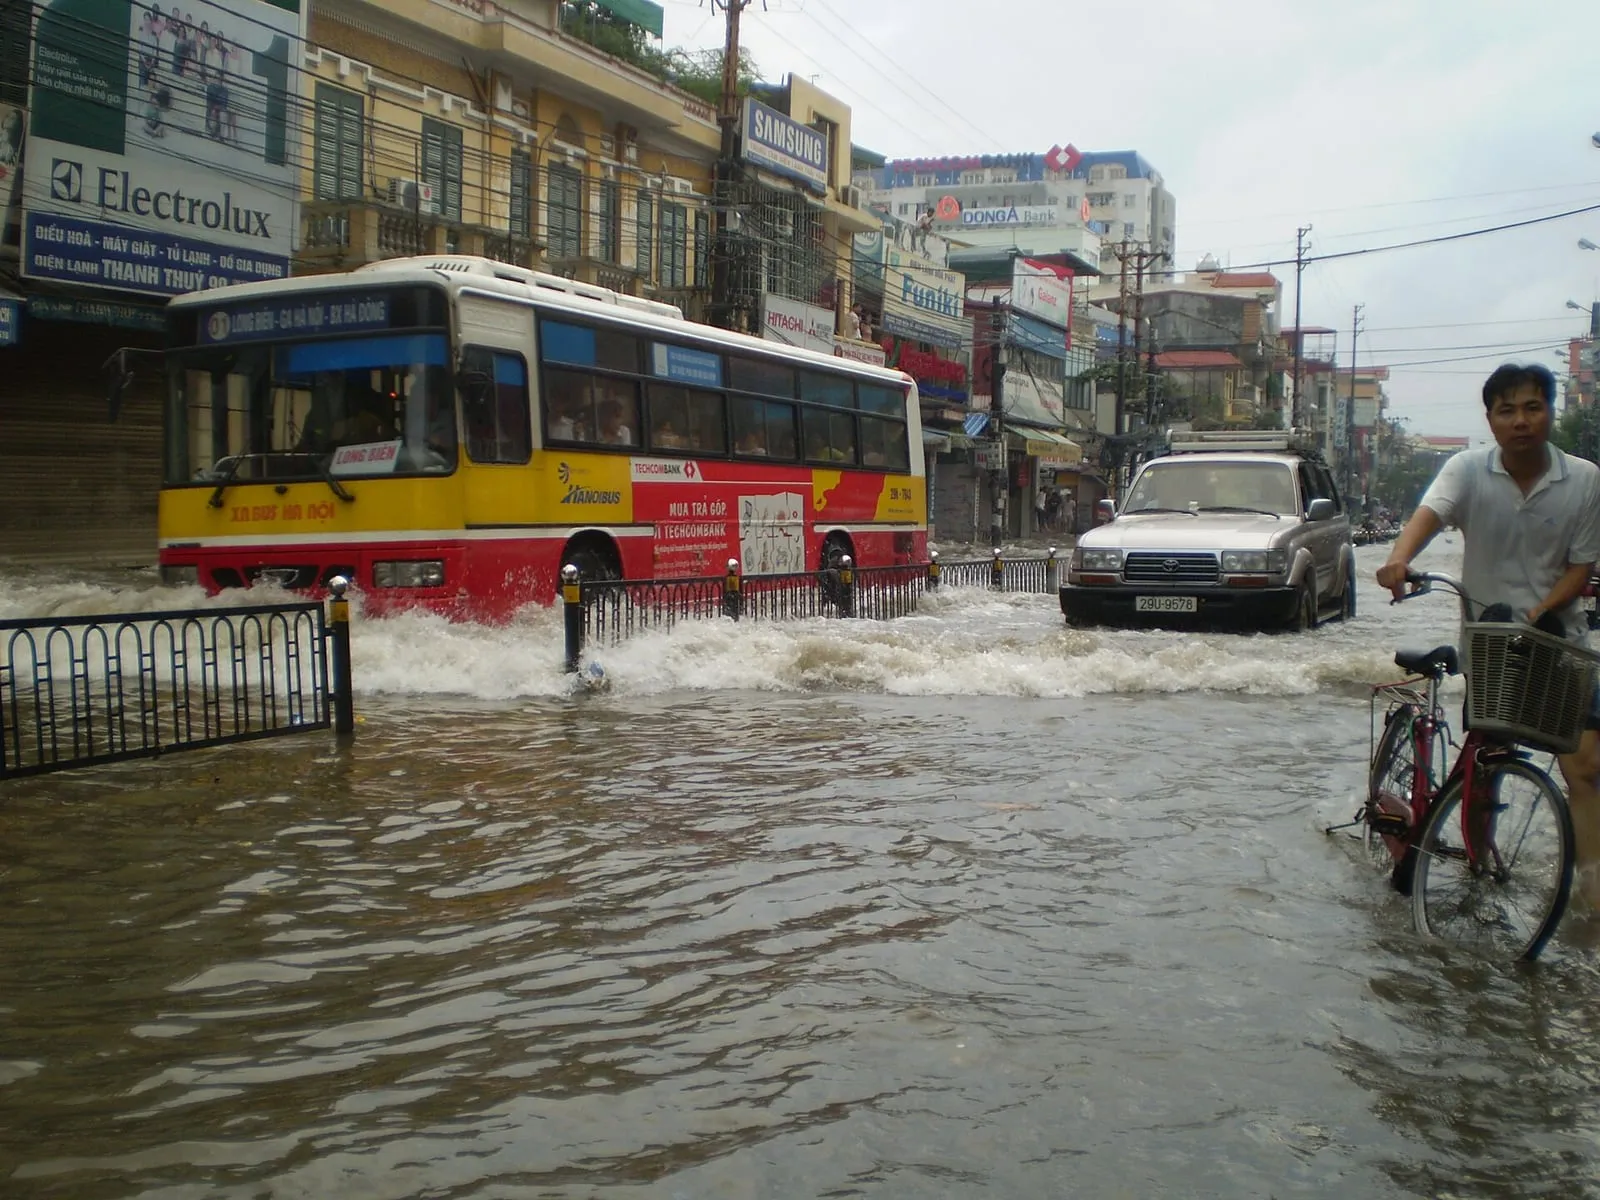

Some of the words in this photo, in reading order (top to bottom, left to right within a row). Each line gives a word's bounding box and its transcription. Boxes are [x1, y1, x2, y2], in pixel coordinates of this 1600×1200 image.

[754, 109, 822, 166] SAMSUNG
[97, 166, 272, 239] Electrolux
[1023, 208, 1056, 222] Bank
[103, 235, 129, 252] MÁY
[182, 248, 211, 266] LẠNH
[235, 258, 253, 273] GIA
[255, 260, 282, 278] DỤNG
[34, 254, 64, 271] ĐIỆN
[66, 259, 99, 275] LẠNH
[101, 258, 160, 285] THANH
[903, 272, 960, 318] Funiki
[335, 449, 365, 465] LONG
[635, 463, 682, 475] TECHCOMBANK
[669, 502, 689, 517] MUA
[691, 494, 708, 516] TRẢ
[664, 523, 727, 540] TECHCOMBANK
[1140, 598, 1193, 610] 29U-9578
